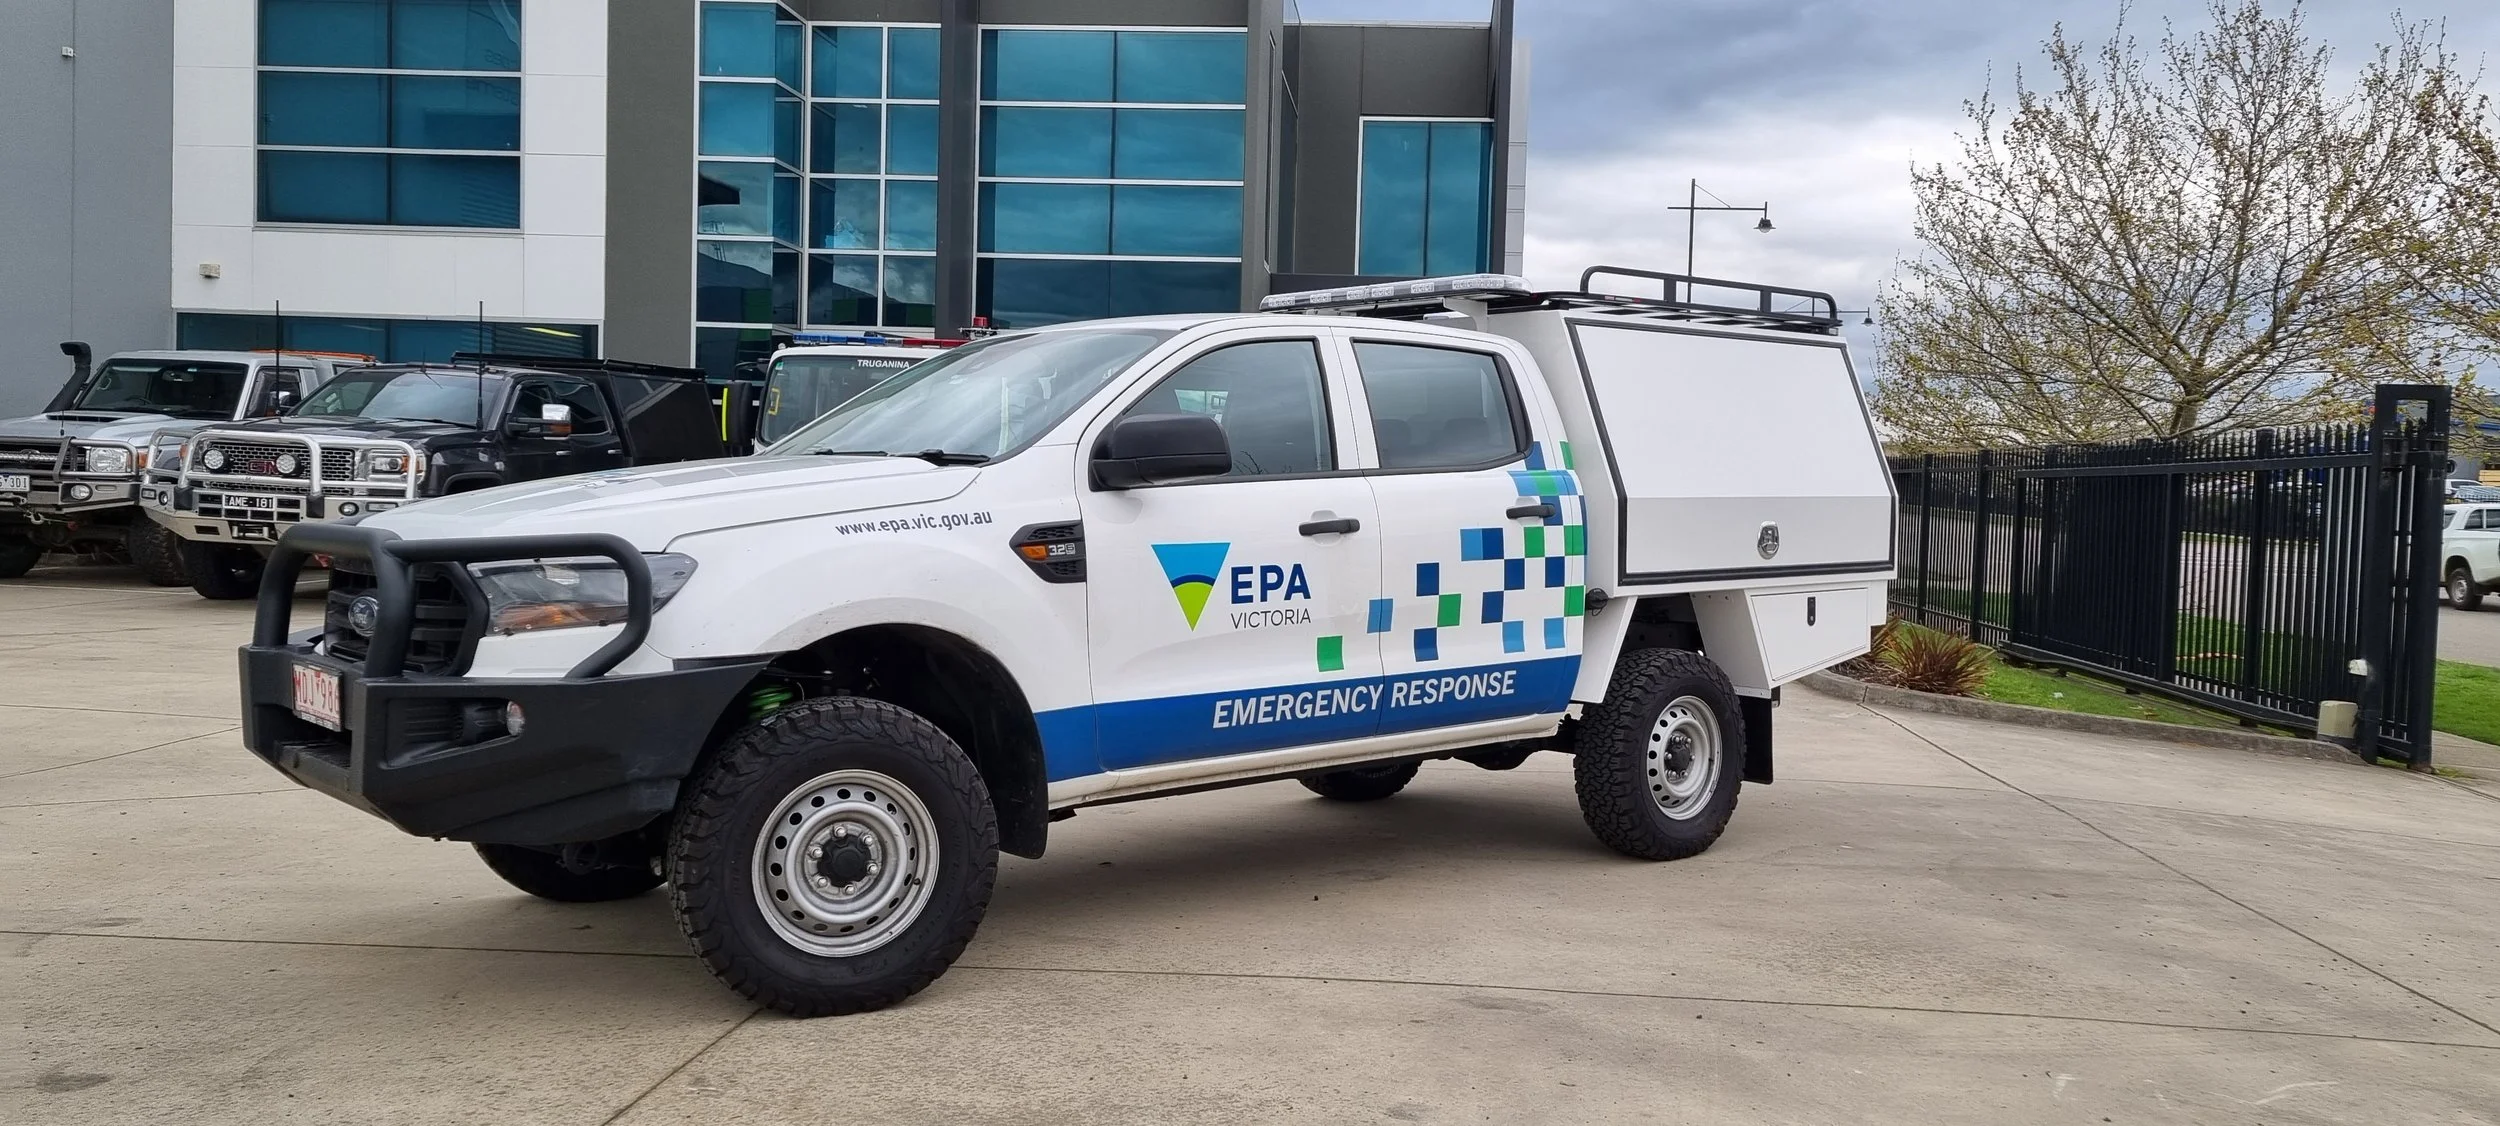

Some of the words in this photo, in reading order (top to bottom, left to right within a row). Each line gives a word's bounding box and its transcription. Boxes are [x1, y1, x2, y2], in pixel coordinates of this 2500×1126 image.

[857, 359, 910, 369] TRUGANINA
[835, 511, 993, 536] www.epa.vic.gov.au
[1230, 563, 1311, 605] EPA
[1230, 608, 1312, 629] VICTORIA
[1212, 684, 1384, 729] EMERGENCY
[1390, 670, 1517, 708] RESPONSE
